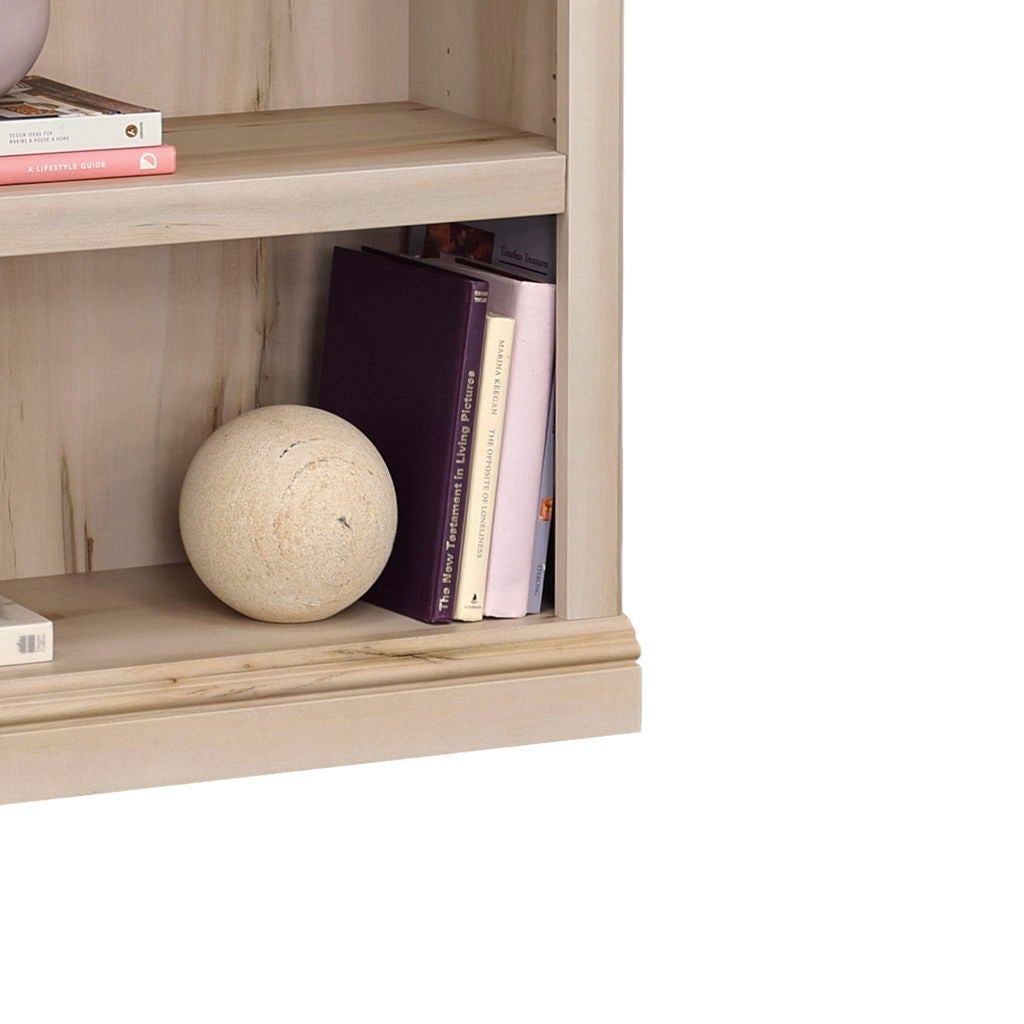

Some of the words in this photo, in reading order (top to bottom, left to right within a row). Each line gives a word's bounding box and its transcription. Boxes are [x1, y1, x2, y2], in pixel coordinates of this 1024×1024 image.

[36, 163, 77, 173] LIFESTYLE
[80, 161, 106, 170] GUIDE
[494, 340, 505, 376] MARINA
[461, 370, 476, 422] Pictures
[491, 379, 501, 415] KEEGAN
[456, 426, 471, 463] Living
[488, 429, 496, 447] THE
[454, 467, 464, 480] in
[482, 449, 494, 491] OPPOSITE
[446, 483, 462, 550] Testament
[481, 493, 489, 505] OF
[476, 506, 487, 558] LONELINESS
[442, 553, 454, 583] New
[439, 588, 450, 611] The
